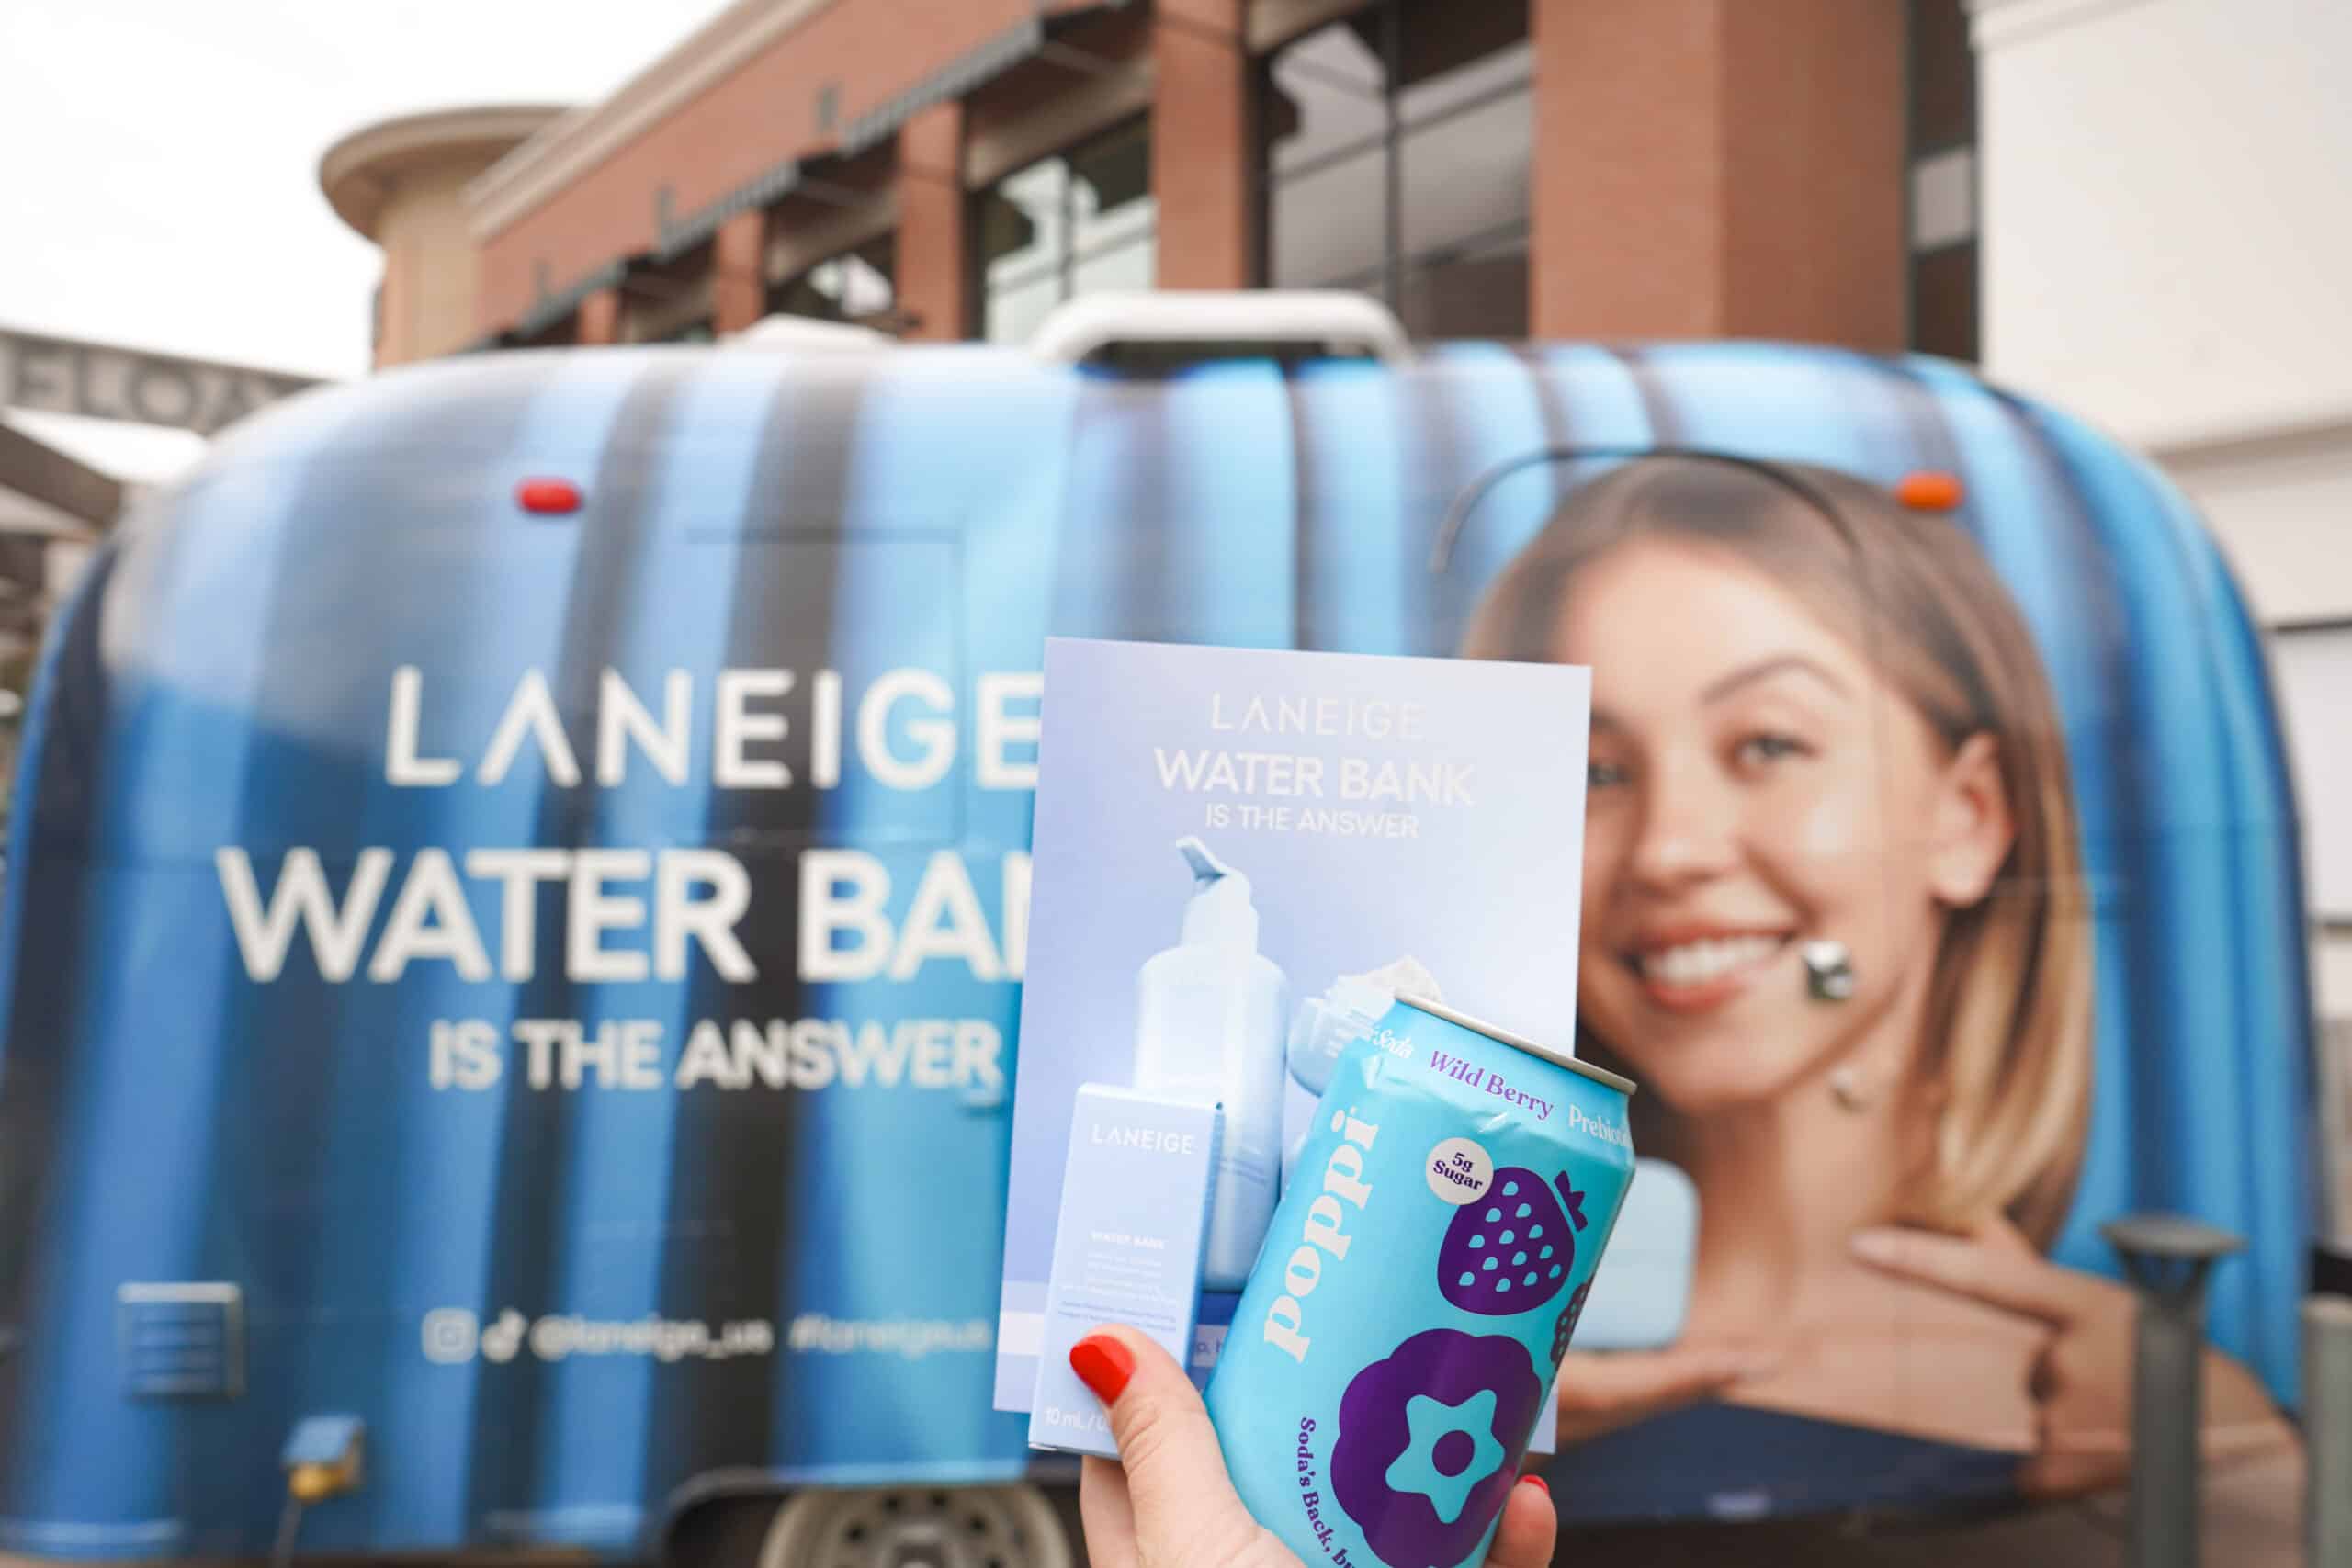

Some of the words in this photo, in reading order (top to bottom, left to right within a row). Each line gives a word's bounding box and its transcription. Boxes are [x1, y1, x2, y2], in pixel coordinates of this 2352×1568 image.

[385, 664, 1045, 792] LANEIGE
[1210, 692, 1427, 740] LANEIGE
[1153, 747, 1324, 798] WATER
[1339, 757, 1477, 807] BANK
[1205, 803, 1231, 829] IS
[1238, 804, 1292, 831] THE
[1297, 808, 1419, 839] ANSWER
[215, 845, 757, 985] WATER
[797, 845, 1033, 985] BA
[430, 1018, 502, 1090] IS
[514, 1019, 663, 1090] THE
[674, 1020, 1004, 1091] ANSWER
[1430, 1050, 1485, 1088] Wild
[1485, 1073, 1554, 1122] Berry
[1091, 1124, 1195, 1155] LANEIGE
[1452, 1152, 1474, 1173] 5g
[1432, 1159, 1483, 1191] Sugar
[1263, 1105, 1379, 1364] poppi
[1296, 1416, 1317, 1487] Soda's
[1302, 1491, 1334, 1553] Back,
